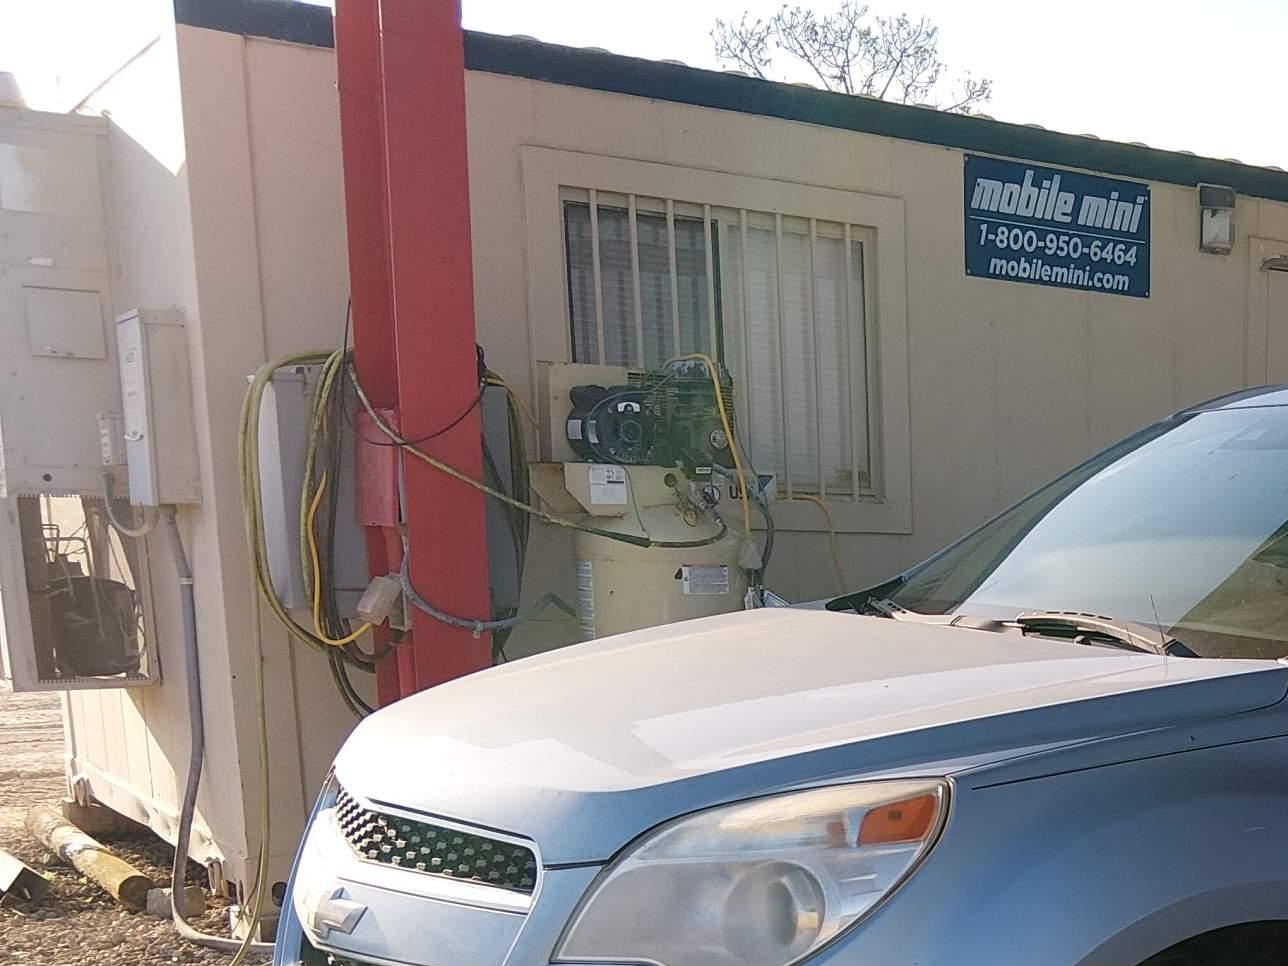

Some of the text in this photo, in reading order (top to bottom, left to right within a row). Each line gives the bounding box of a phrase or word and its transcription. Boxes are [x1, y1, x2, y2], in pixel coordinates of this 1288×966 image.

[971, 169, 1144, 233] mobile mini
[979, 224, 1137, 266] 1-800-950-6464
[989, 257, 1130, 291] mobilemini.com
